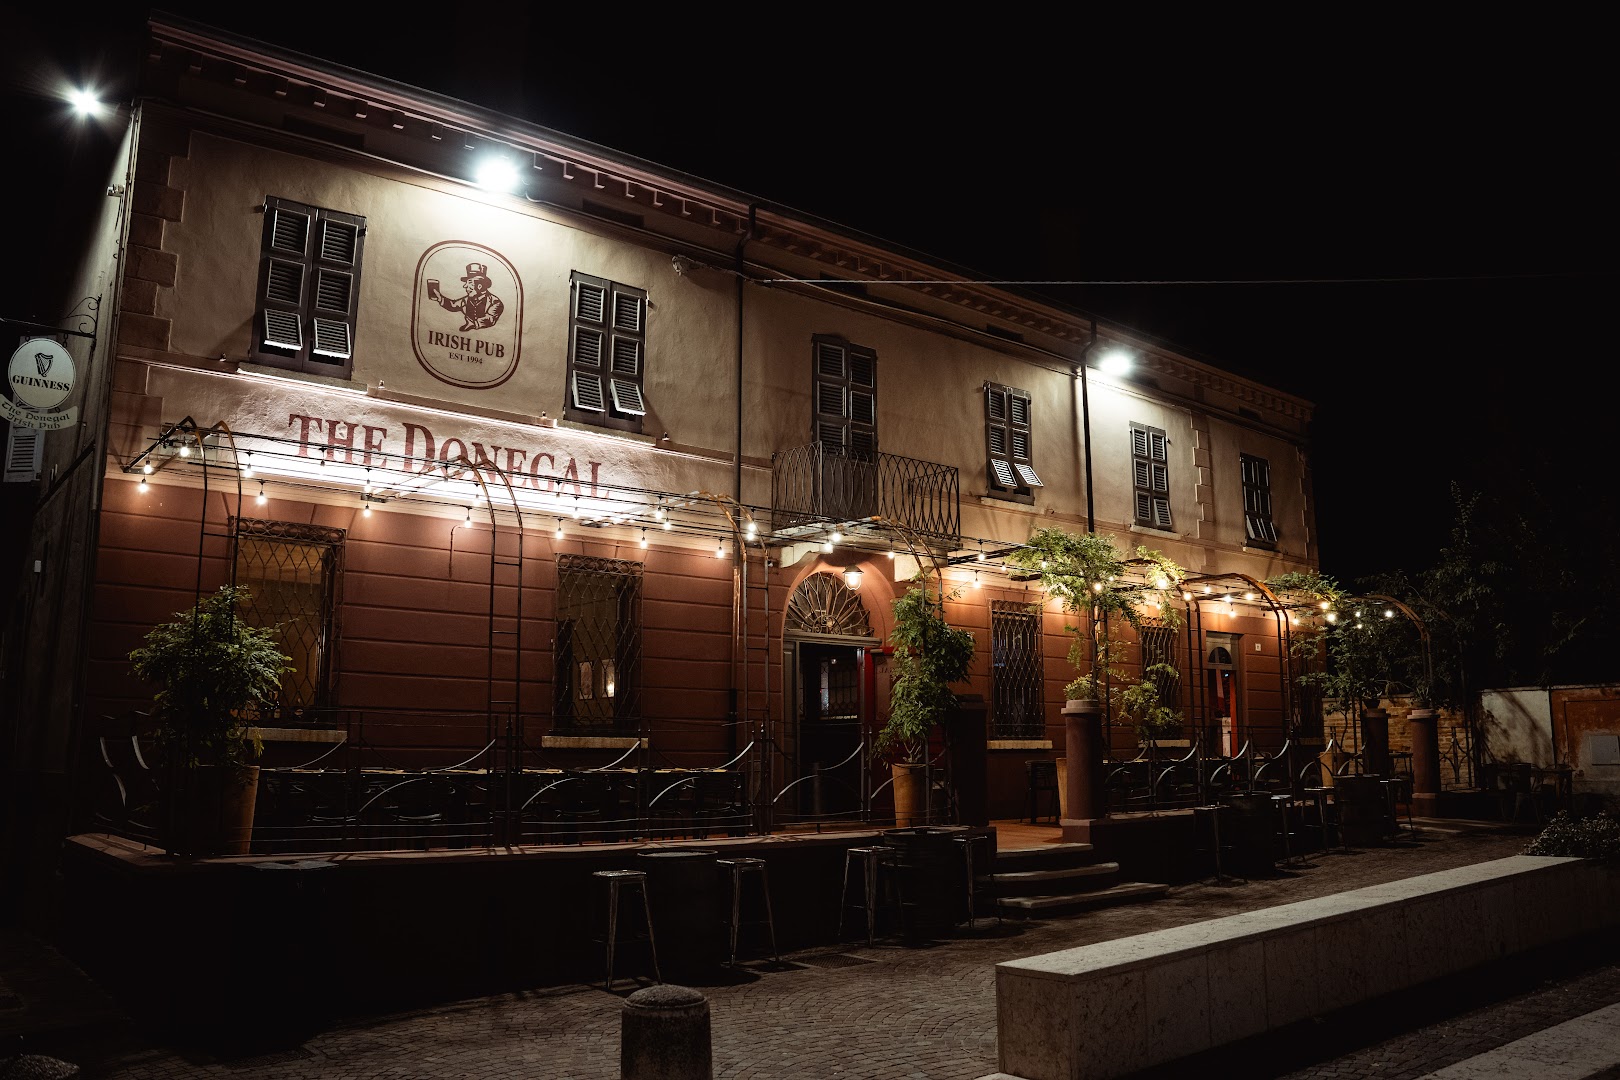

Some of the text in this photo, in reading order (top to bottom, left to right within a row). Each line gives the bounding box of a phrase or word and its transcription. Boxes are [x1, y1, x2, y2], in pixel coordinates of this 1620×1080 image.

[428, 330, 505, 358] IRISH PUB
[449, 352, 483, 364] EST 1994
[12, 374, 70, 392] GUINNESS
[1, 401, 70, 422] The Donegal
[7, 413, 34, 428] Irish
[288, 413, 610, 499] THE DONEGAL
